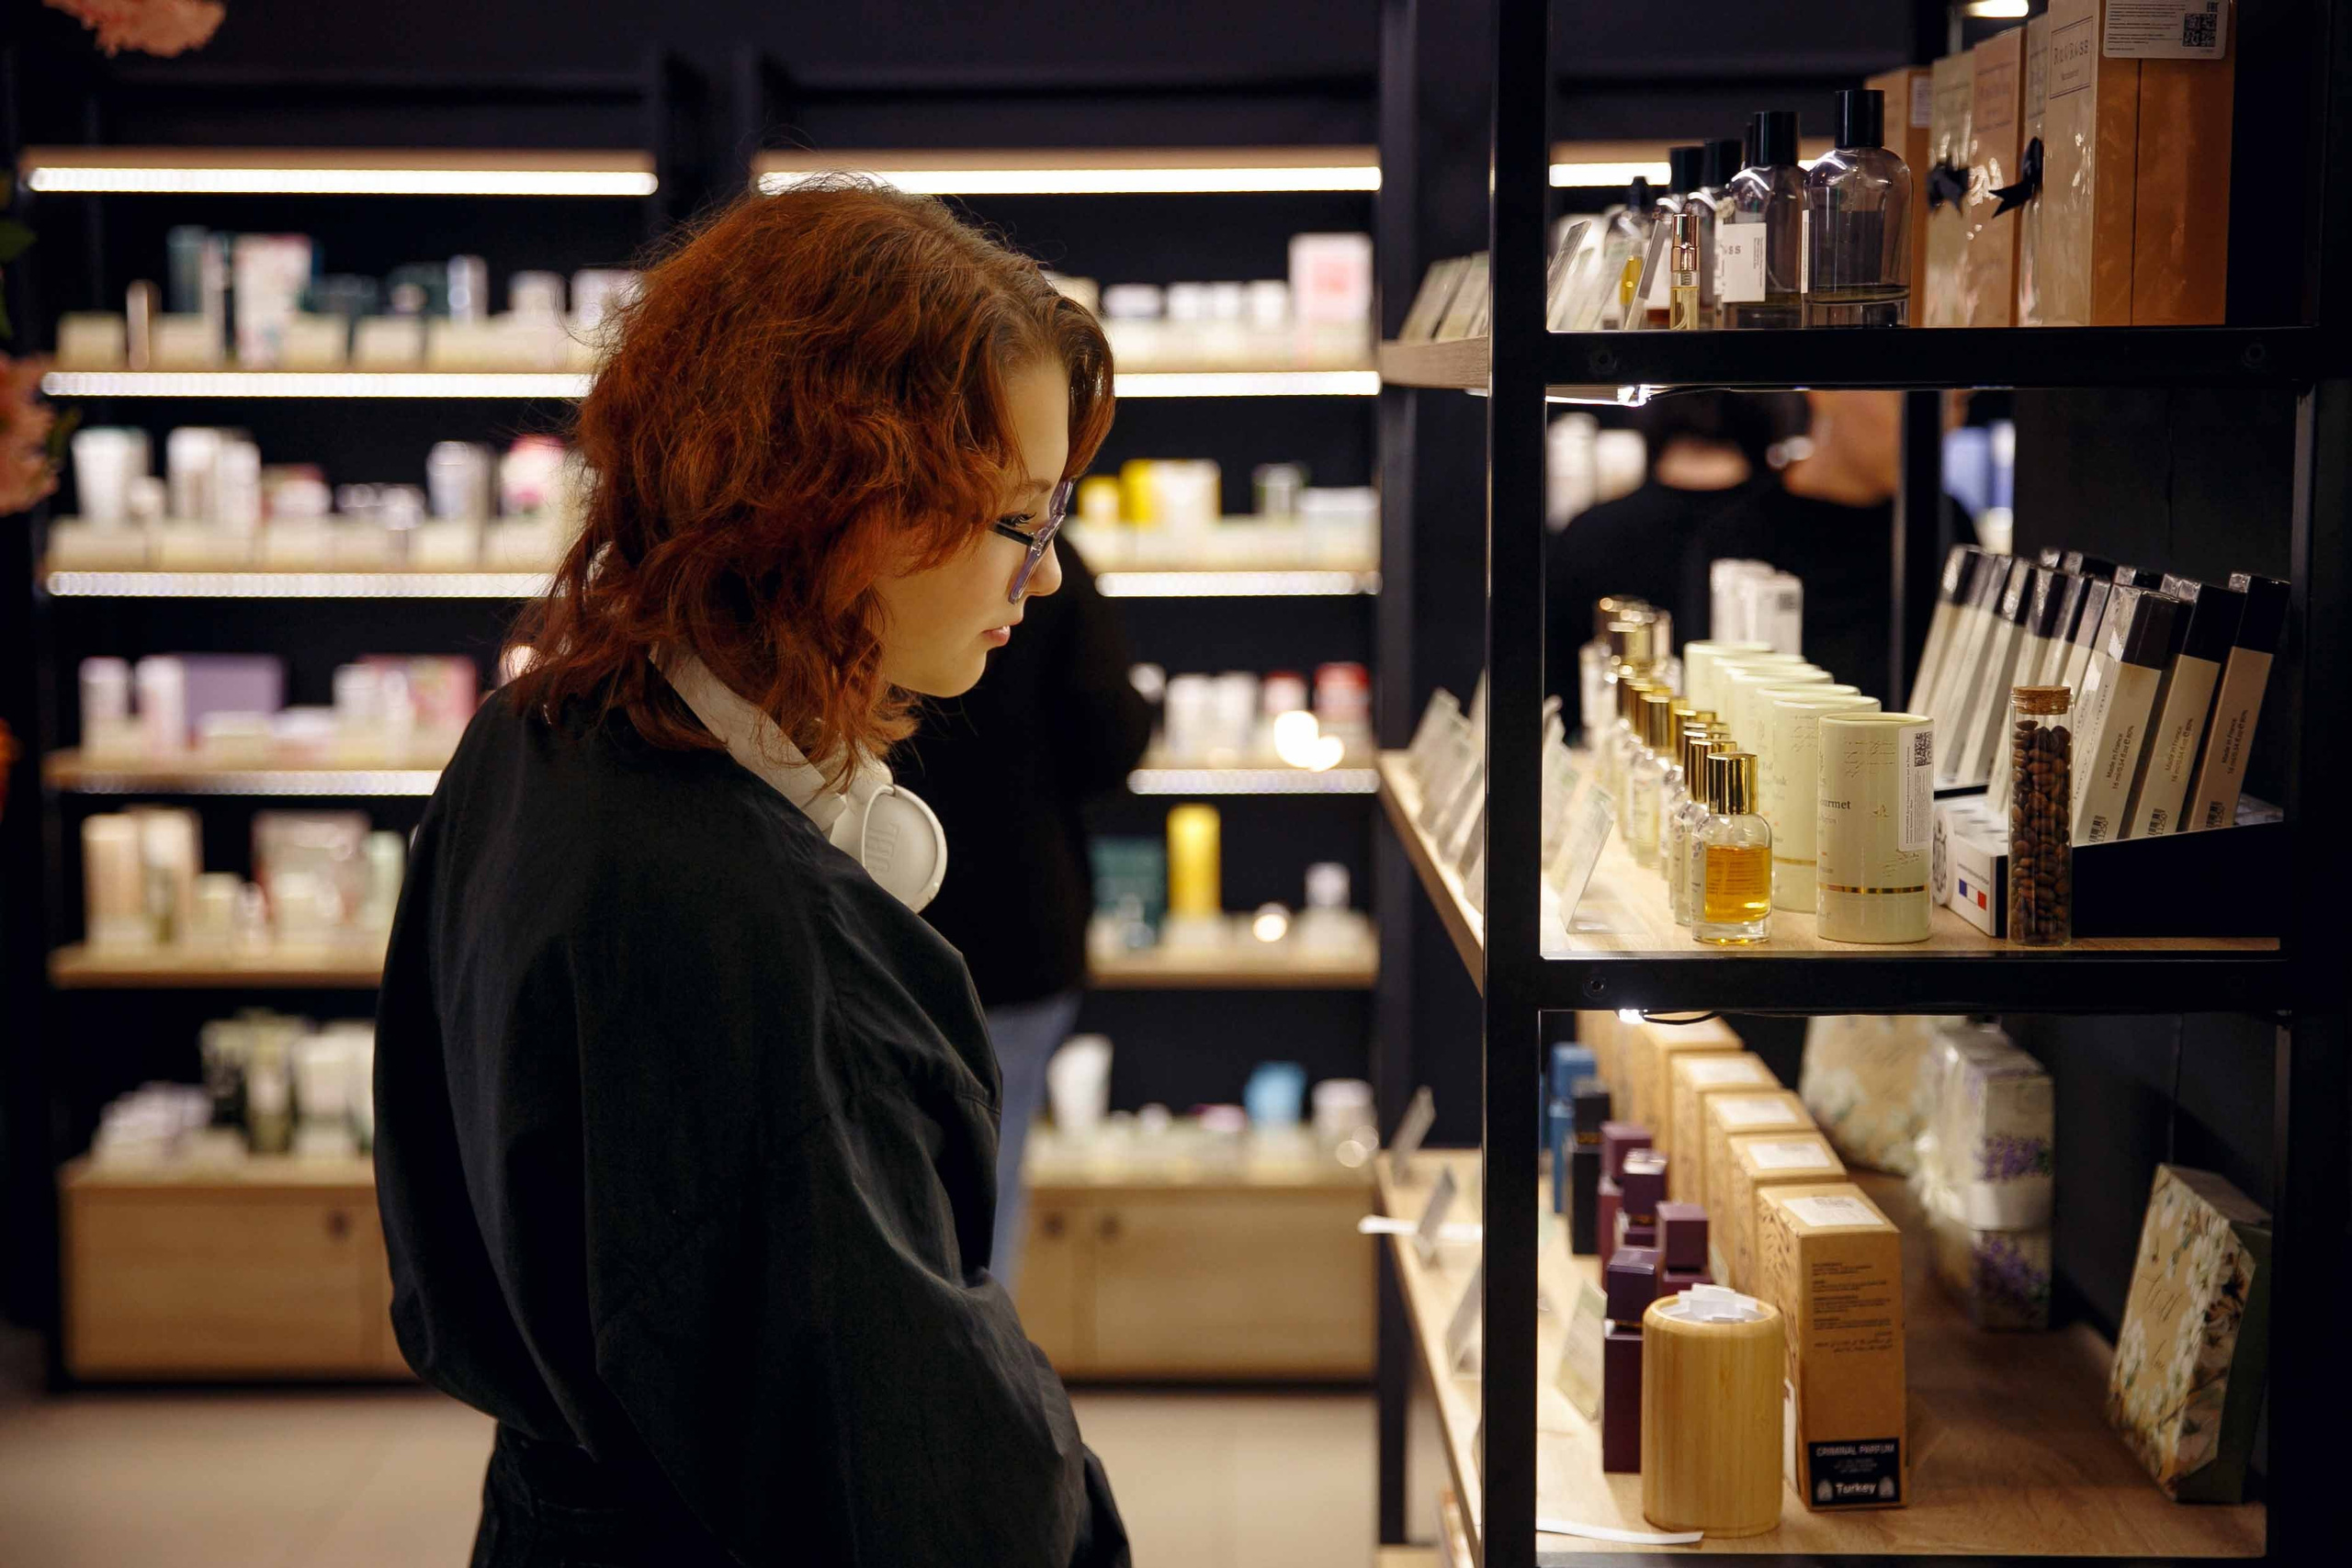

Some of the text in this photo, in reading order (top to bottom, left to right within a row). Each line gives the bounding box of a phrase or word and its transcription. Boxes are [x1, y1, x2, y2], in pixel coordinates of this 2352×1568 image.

[2107, 761, 2115, 778] Made
[2113, 733, 2123, 753] France
[2165, 754, 2175, 771] Made
[2172, 726, 2182, 747] France
[2222, 747, 2230, 763] Made
[2227, 718, 2237, 739] France
[866, 821, 899, 873] JBL
[1859, 1442, 1895, 1455] PARFUM
[1835, 1482, 1877, 1495] Turkey
